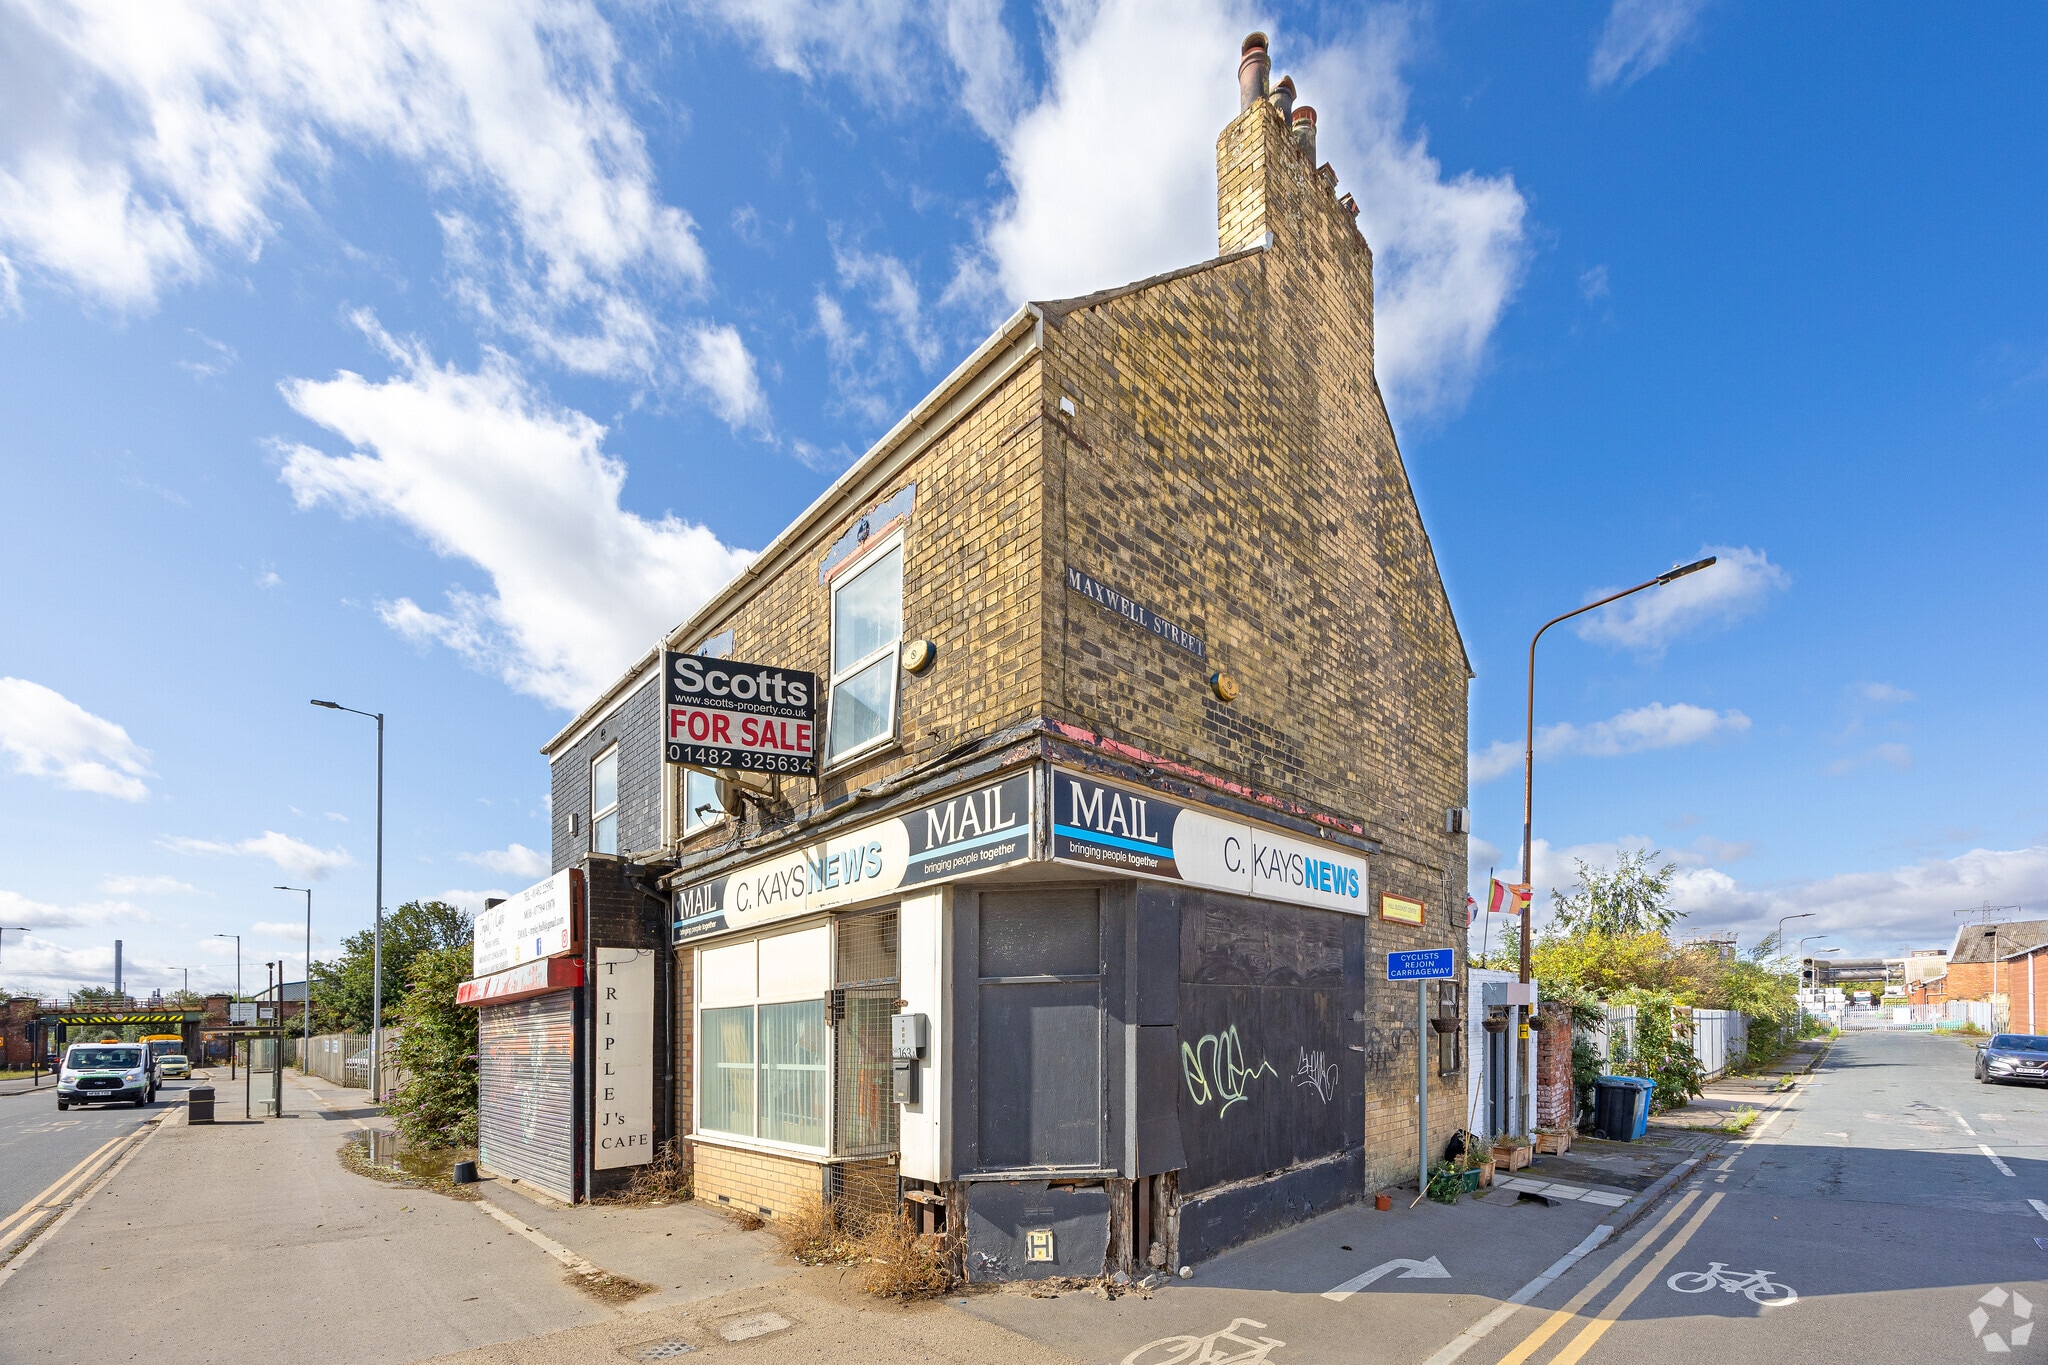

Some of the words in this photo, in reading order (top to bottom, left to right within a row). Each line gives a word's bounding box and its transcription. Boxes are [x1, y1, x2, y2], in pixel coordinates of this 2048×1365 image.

[1068, 567, 1147, 628] MAXWELL
[1153, 616, 1205, 657] STREET
[673, 657, 808, 707] Scotts
[674, 694, 807, 718] www.scotts-property.co.uk
[670, 708, 733, 744] FOR
[741, 717, 811, 753] SALE
[669, 745, 732, 766] 01482
[741, 752, 812, 773] 325634
[925, 785, 1016, 849] MAIL
[1069, 780, 1159, 843] MAIL
[924, 859, 952, 874] bringing
[952, 852, 979, 869] people
[980, 843, 1016, 860] together
[1069, 841, 1101, 859] bringing
[1102, 848, 1127, 862] people
[1128, 853, 1159, 868] together
[1224, 836, 1245, 874] C.
[679, 884, 717, 919] MAIL
[736, 882, 753, 912] C.
[1400, 952, 1440, 961] CYCLISTS
[1405, 961, 1435, 969] REJOIN
[1390, 967, 1450, 977] CARRIAGEWAY
[604, 962, 618, 1101] TRIPLE
[602, 1112, 625, 1126] J's
[601, 1133, 649, 1150] CAFE
